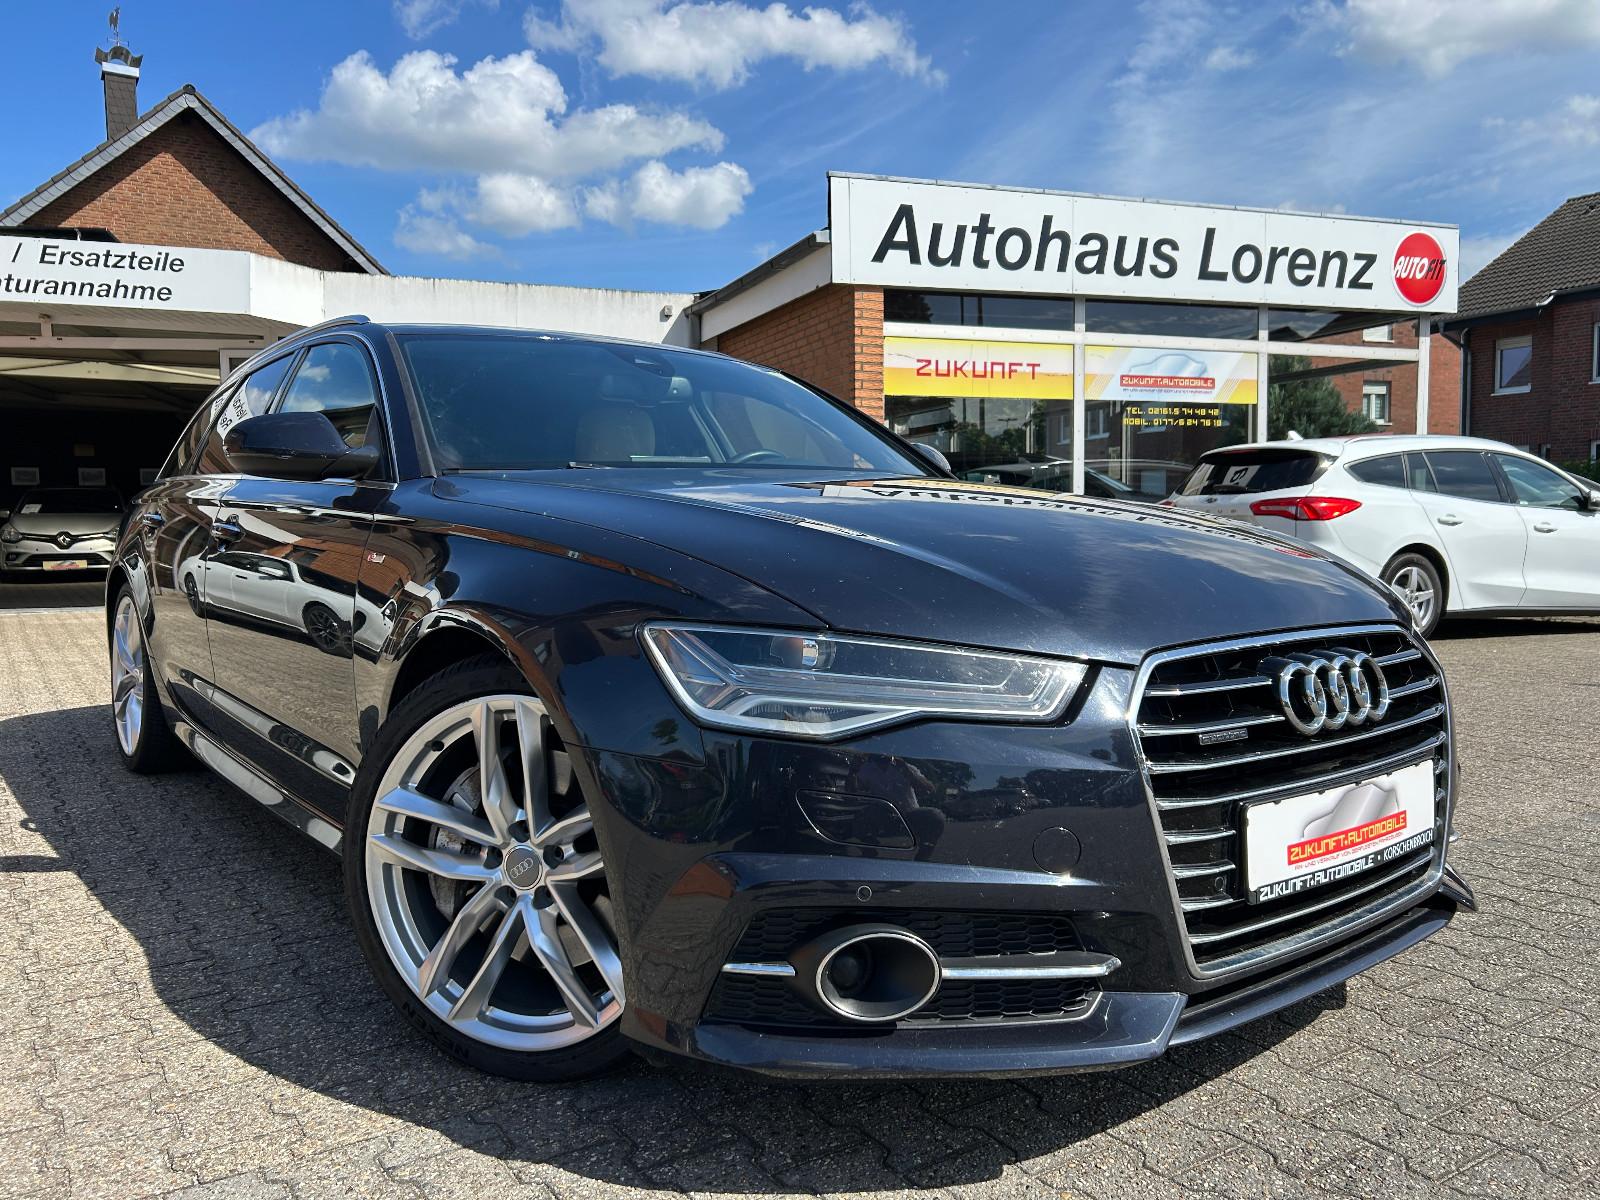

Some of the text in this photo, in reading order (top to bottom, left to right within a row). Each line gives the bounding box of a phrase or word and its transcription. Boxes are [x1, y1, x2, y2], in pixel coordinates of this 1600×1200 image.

[39, 244, 185, 273] Ersatzteile
[871, 204, 1378, 291] Autohaus Lorenz
[1394, 255, 1447, 280] AUTOFIT
[0, 273, 173, 302] turannahme
[916, 359, 1041, 380] ZUKUNFT
[1182, 408, 1193, 416] 74
[1383, 828, 1433, 861] KORSCHENBROICH
